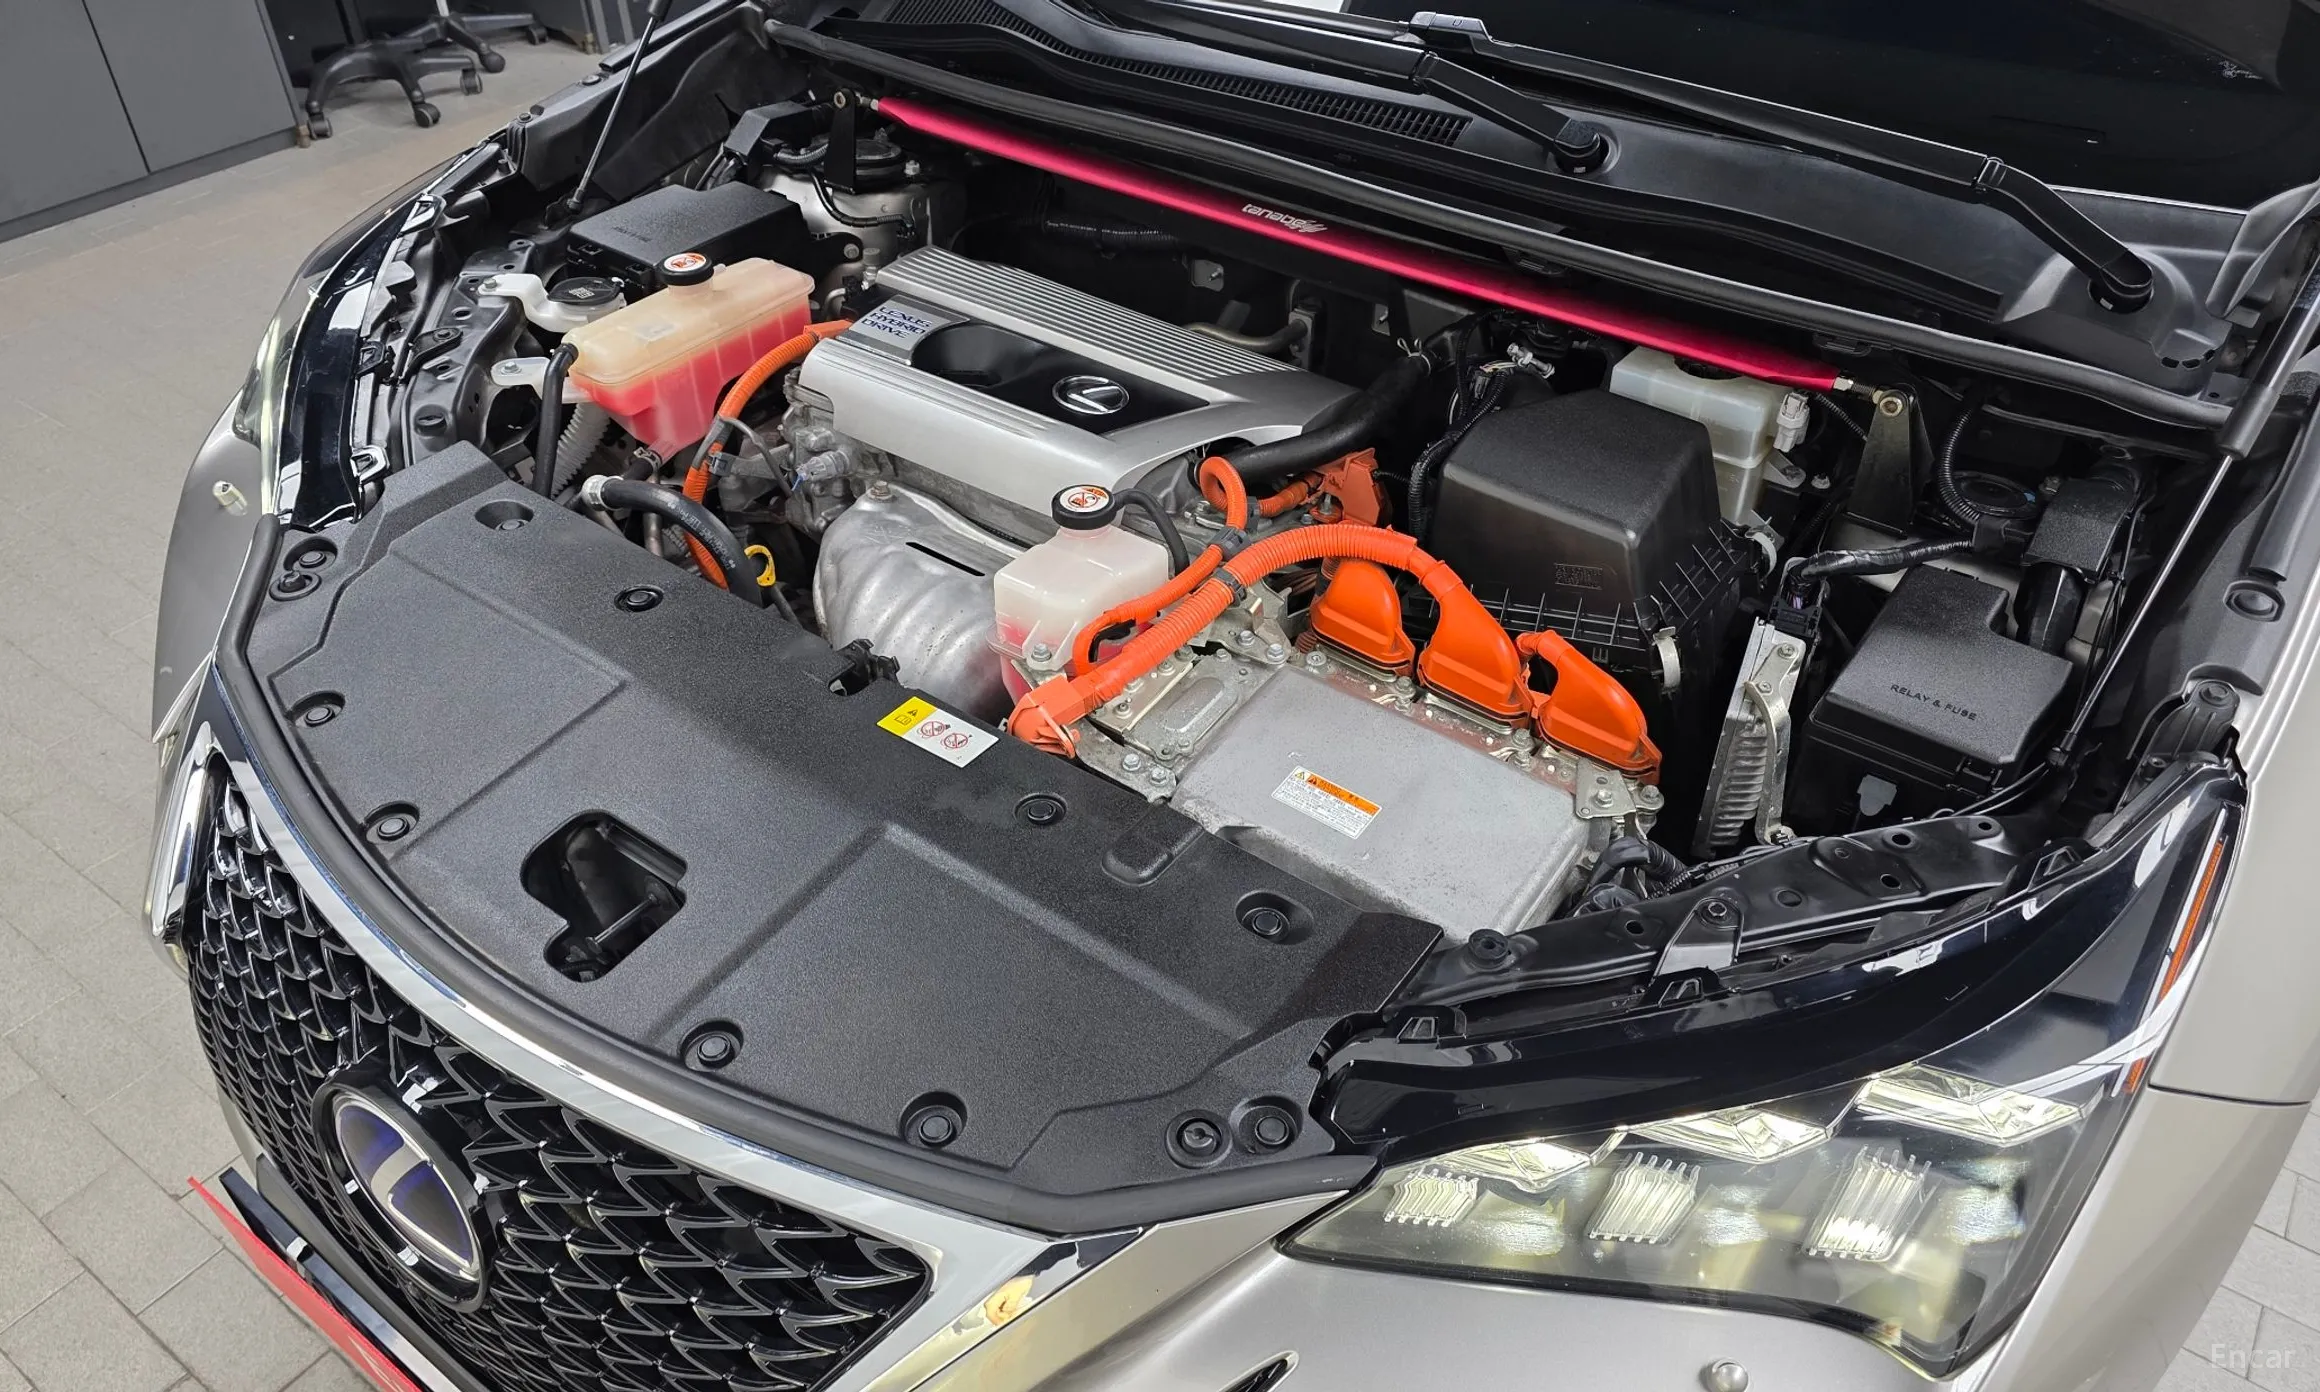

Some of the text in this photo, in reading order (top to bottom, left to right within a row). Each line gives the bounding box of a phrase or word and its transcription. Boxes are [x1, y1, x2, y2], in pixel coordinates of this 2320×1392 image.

[1241, 203, 1307, 227] tanabe
[870, 312, 927, 334] HYBRID
[879, 306, 932, 328] LEXUS
[861, 318, 909, 339] DRIVE
[1890, 684, 1978, 721] RELAY & FUSE
